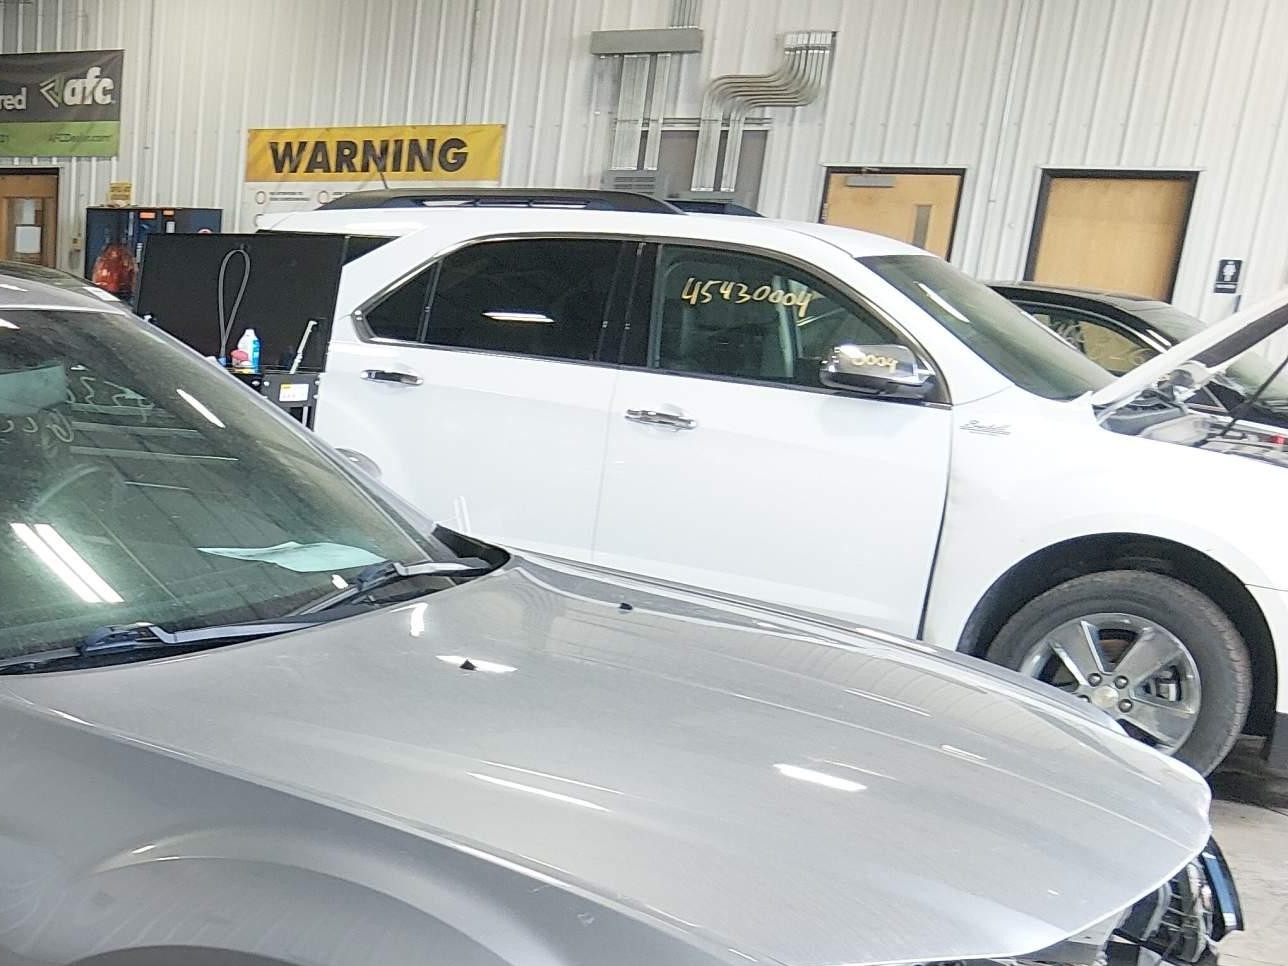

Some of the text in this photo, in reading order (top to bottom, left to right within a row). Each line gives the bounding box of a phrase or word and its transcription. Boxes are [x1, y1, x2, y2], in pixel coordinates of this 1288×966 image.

[64, 67, 114, 105] afc
[269, 138, 469, 173] WARNING
[681, 277, 812, 317] 45430004
